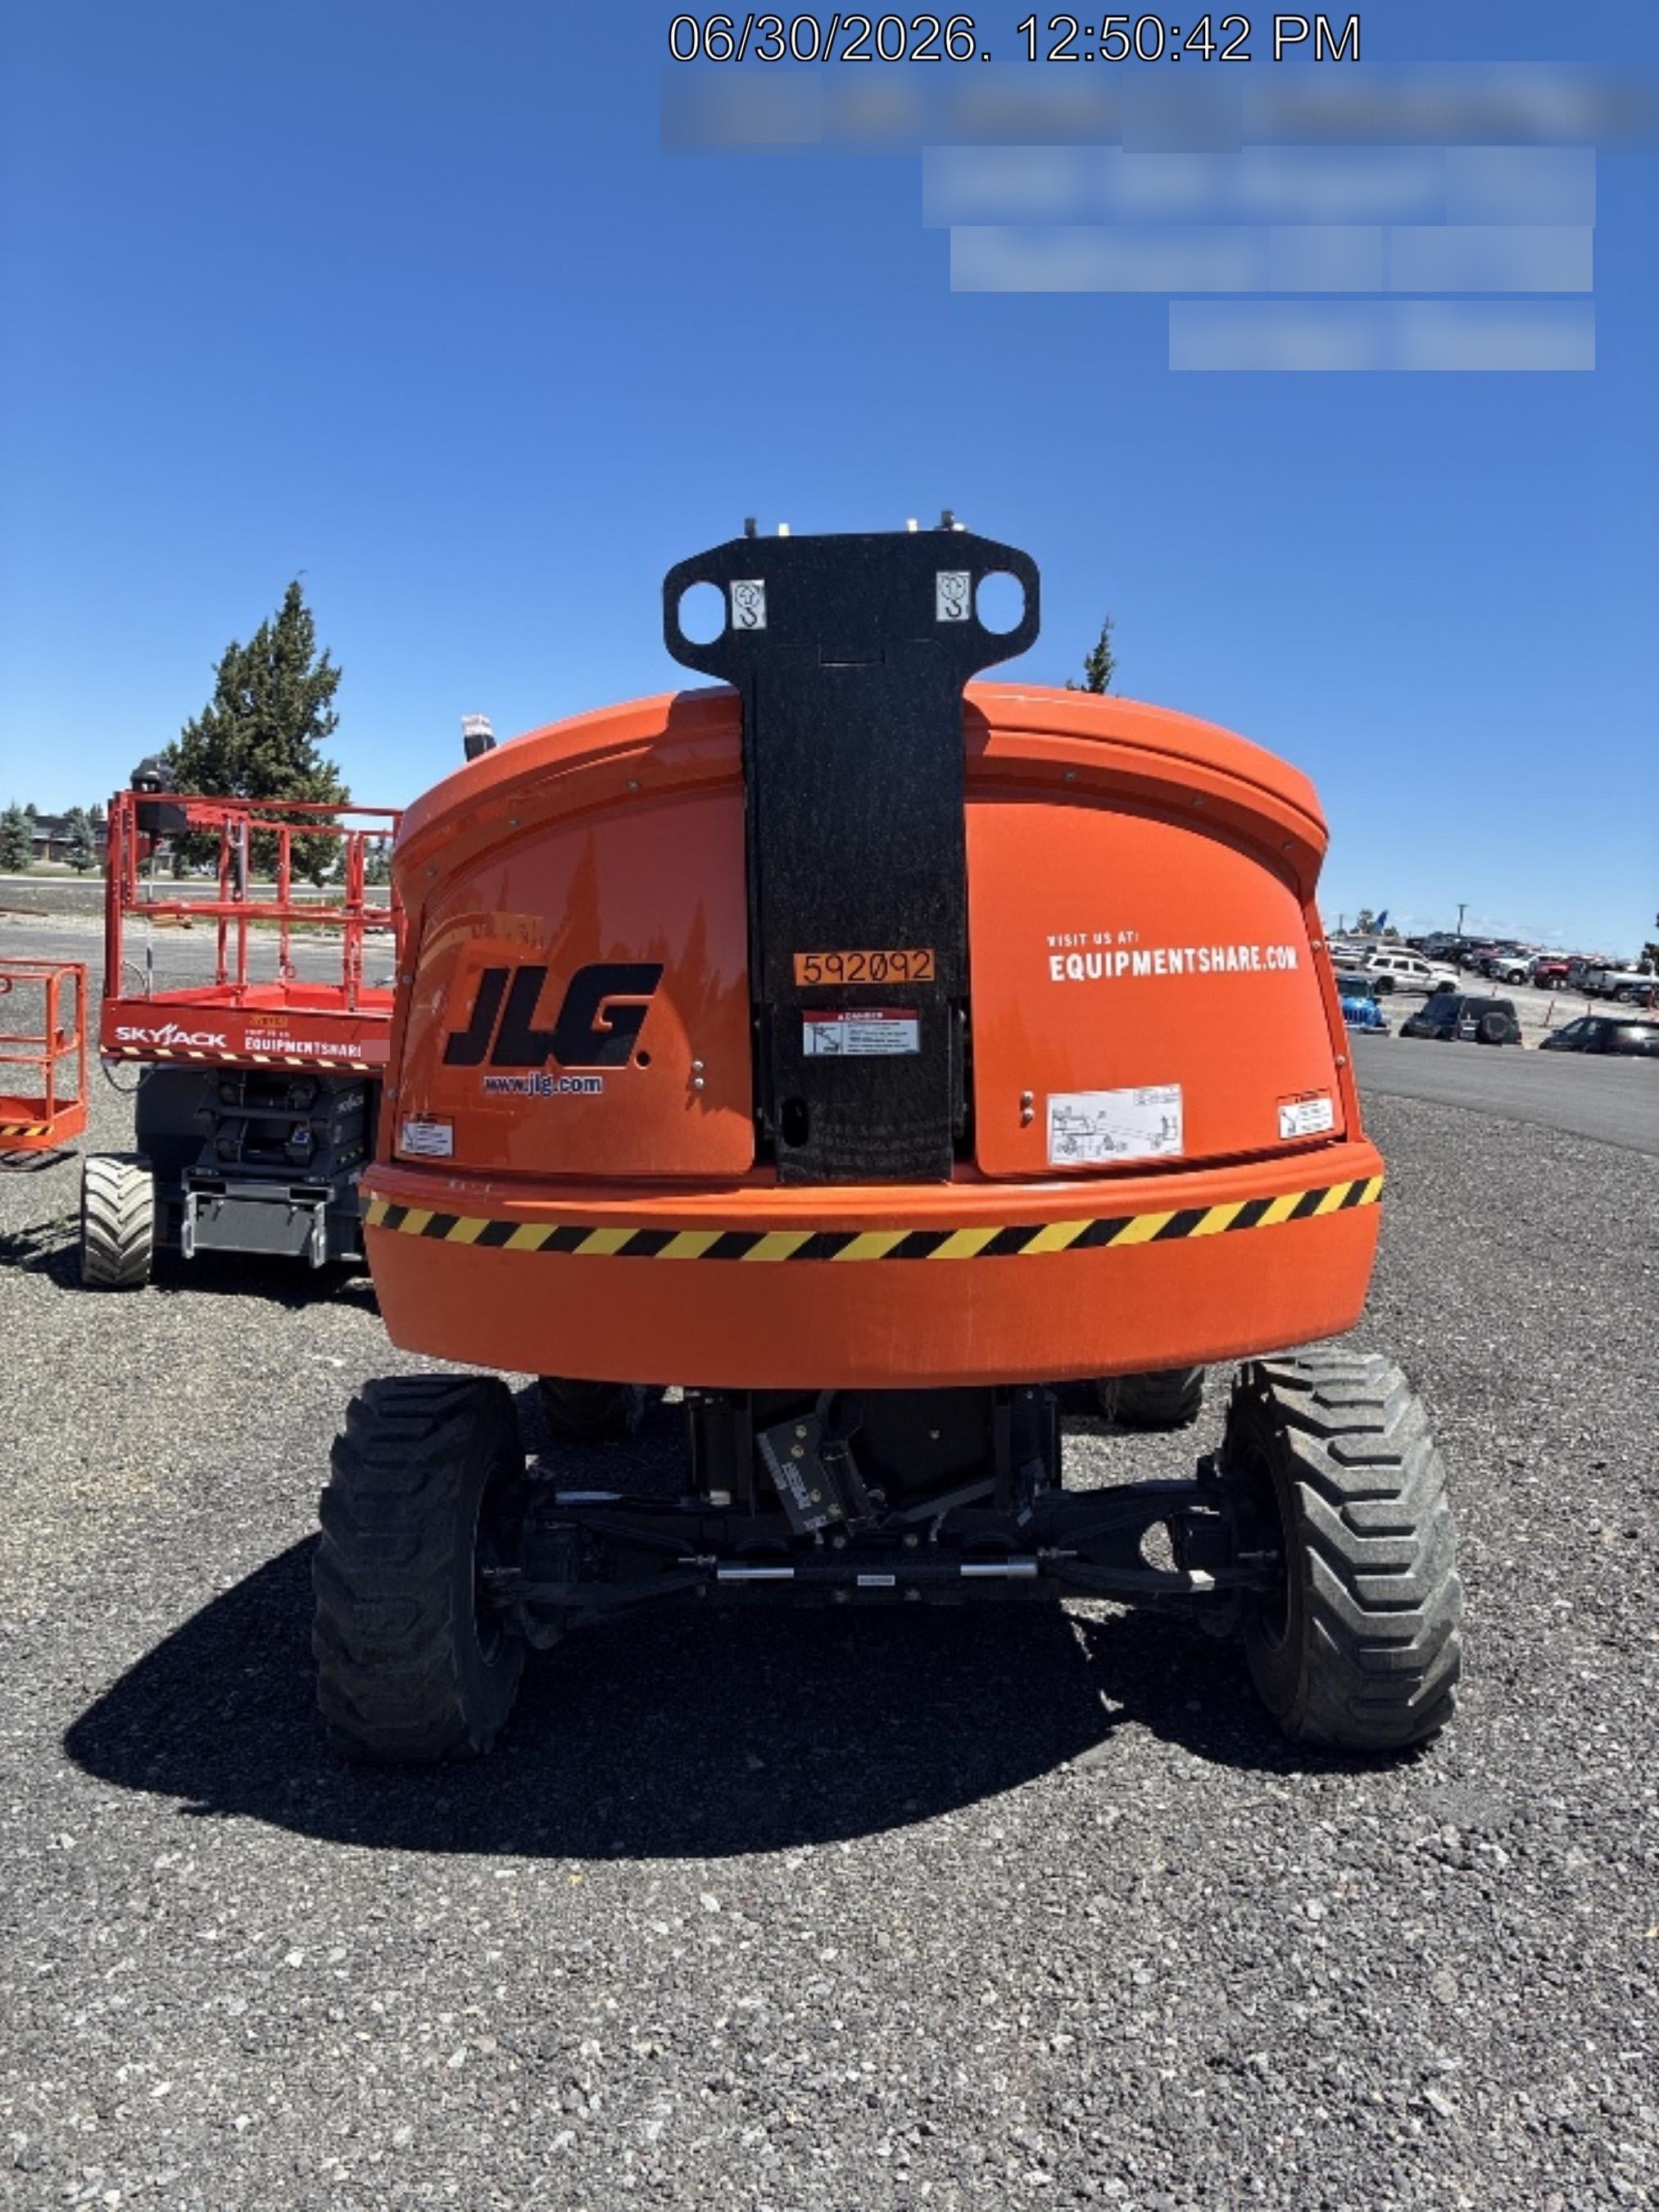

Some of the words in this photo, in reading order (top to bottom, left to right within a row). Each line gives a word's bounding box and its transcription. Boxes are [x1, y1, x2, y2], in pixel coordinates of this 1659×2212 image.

[1047, 932, 1086, 947] VISIT
[1094, 932, 1112, 945] US
[804, 951, 931, 983] 592092
[1049, 945, 1298, 981] EQUIPMENTSHARE.COM
[443, 963, 664, 1067] JLG
[116, 1022, 227, 1048] SKYJACK
[484, 1073, 603, 1096] www.jlg.com
